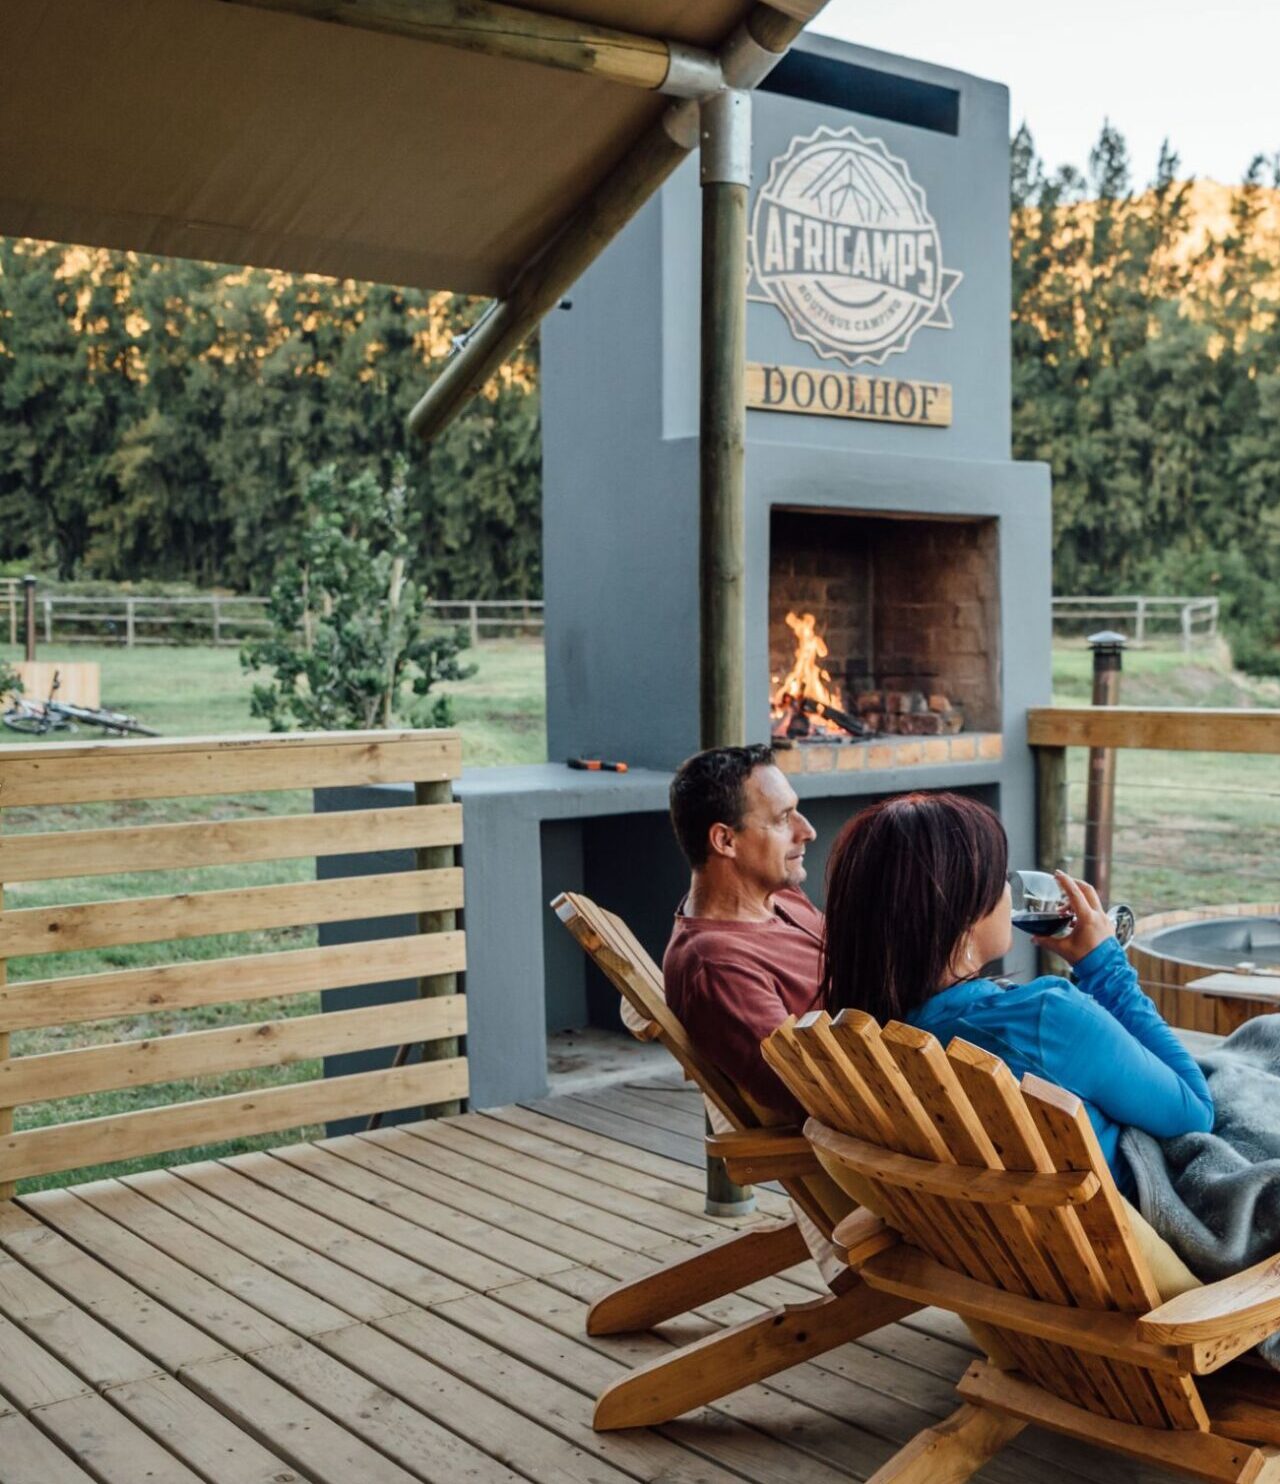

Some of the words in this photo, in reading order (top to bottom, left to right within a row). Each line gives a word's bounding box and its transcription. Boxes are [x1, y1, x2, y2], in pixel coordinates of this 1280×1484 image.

[764, 206, 935, 298] AFRICAMPS
[798, 284, 851, 332] BOUTIQUE
[854, 298, 903, 333] CAMPING
[762, 366, 939, 420] DOOLHOF
